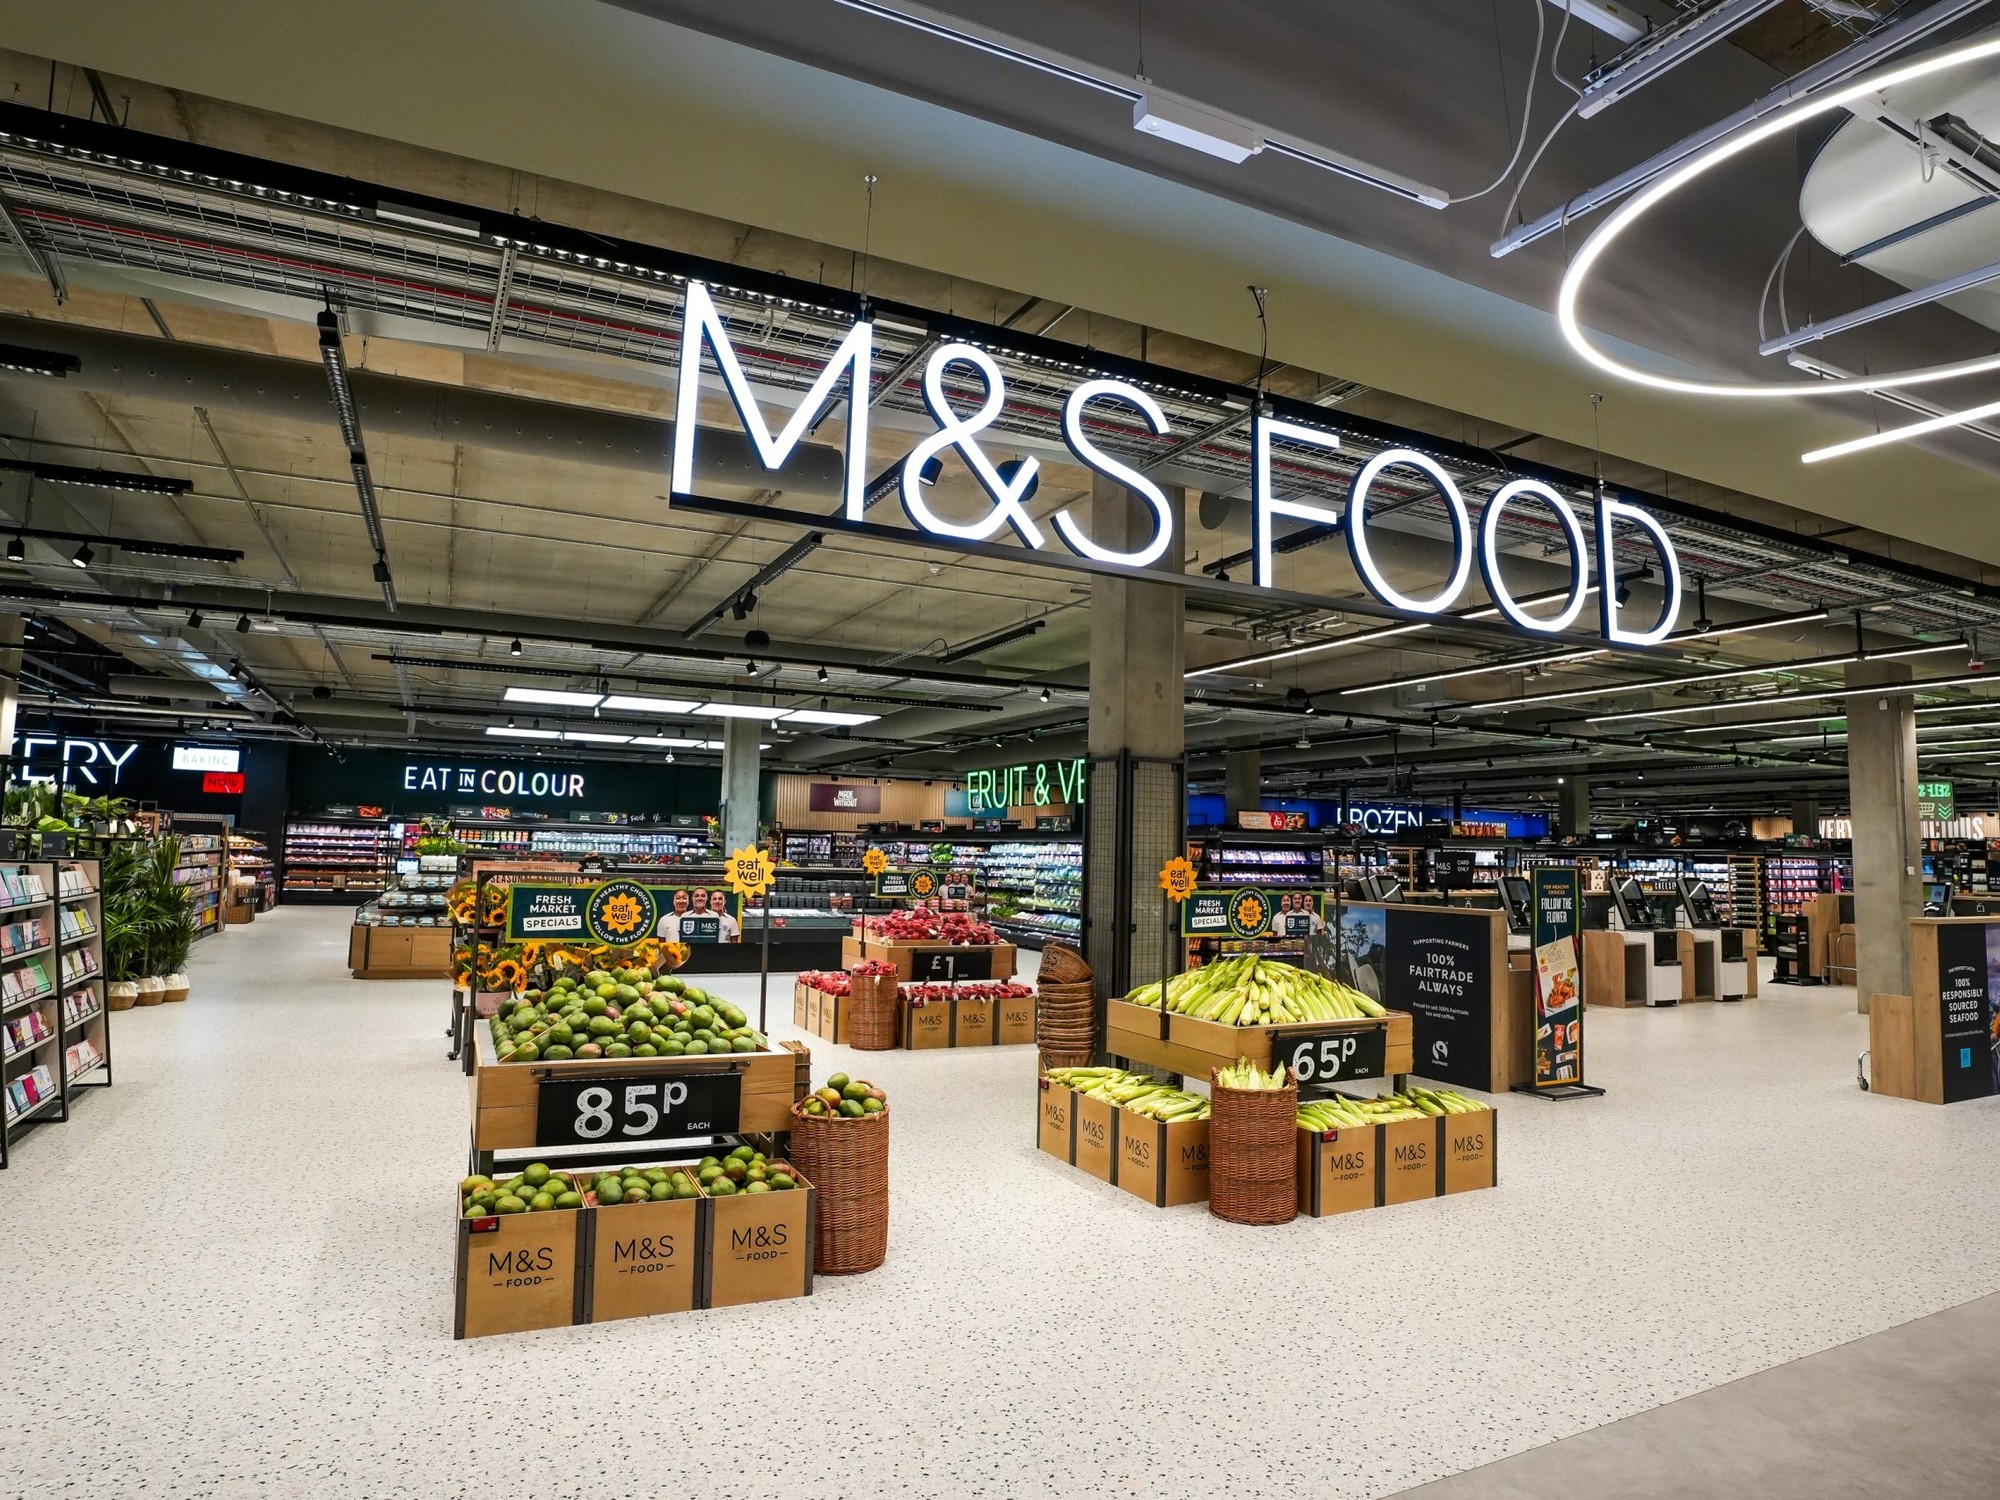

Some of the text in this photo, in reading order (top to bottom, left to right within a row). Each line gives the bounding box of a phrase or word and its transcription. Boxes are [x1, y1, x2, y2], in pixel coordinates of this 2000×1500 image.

[670, 281, 1682, 646] M&S FOOD
[11, 738, 138, 784] ERY
[182, 754, 230, 766] BAKING
[207, 778, 239, 788] NOW
[404, 766, 452, 791] EAT
[481, 770, 585, 797] COLOUR
[967, 765, 1028, 810] FRUIT
[1033, 763, 1051, 806] &
[838, 790, 854, 799] MADE
[834, 797, 858, 808] WITHOUT
[737, 858, 761, 870] eat
[1436, 862, 1451, 871] M&S
[737, 868, 764, 881] well
[1171, 870, 1186, 878] eat
[1171, 876, 1189, 888] well
[535, 894, 572, 904] FRESH
[592, 884, 651, 912] FOR HEALTHY CHOICES
[1541, 897, 1573, 910] FOLLOW THE
[529, 904, 577, 914] MARKET
[611, 903, 630, 912] eat
[1195, 906, 1224, 914] MARKET
[611, 910, 633, 921] well
[1243, 911, 1257, 919] well
[1546, 911, 1567, 923] FLOWER
[526, 918, 579, 929] SPECIALS
[701, 922, 717, 930] M&S
[1193, 917, 1225, 926] SPECIALS
[593, 920, 614, 941] FOLLOW
[630, 919, 650, 941] FLOWER
[1413, 938, 1469, 951] SUPPORTING FARMERS
[1426, 953, 1455, 966] 100%
[931, 955, 955, 979] £1
[1409, 965, 1473, 983] FAIRTRADE
[1418, 980, 1463, 996] ALWAYS
[1955, 978, 1971, 988] 100%
[1942, 988, 1983, 1000] RESPONSIBLY
[1413, 1001, 1426, 1009] Proud
[1449, 1006, 1469, 1016] Fairtrade
[1949, 1001, 1978, 1012] SOURCED
[918, 1015, 942, 1026] M&S
[962, 1013, 986, 1024] M&S
[1005, 1011, 1029, 1022] M&S
[1949, 1012, 1979, 1024] SEAFOOD
[1292, 1037, 1357, 1081] 65p
[574, 1081, 688, 1139] 85p
[1045, 1102, 1065, 1124] M&S
[687, 1122, 711, 1131] EACH
[1050, 1121, 1061, 1131] FOOD
[1082, 1117, 1104, 1141] M&S
[1087, 1138, 1101, 1149] FOOD
[1125, 1135, 1150, 1160] M&S
[1454, 1134, 1484, 1153] M&S
[1181, 1143, 1210, 1163] M&
[1395, 1142, 1427, 1163] M&S
[1462, 1153, 1479, 1161] FOOD
[1131, 1157, 1146, 1168] FOOD
[1331, 1151, 1365, 1173] M&S
[1403, 1162, 1421, 1171] FOOD
[1340, 1172, 1359, 1181] FOOD
[731, 1223, 788, 1251] M&S
[614, 1234, 675, 1264] M&S
[489, 1246, 554, 1277] M&S
[746, 1249, 778, 1262] FOOD
[630, 1262, 664, 1275] FOOD
[505, 1275, 542, 1289] FOOD
